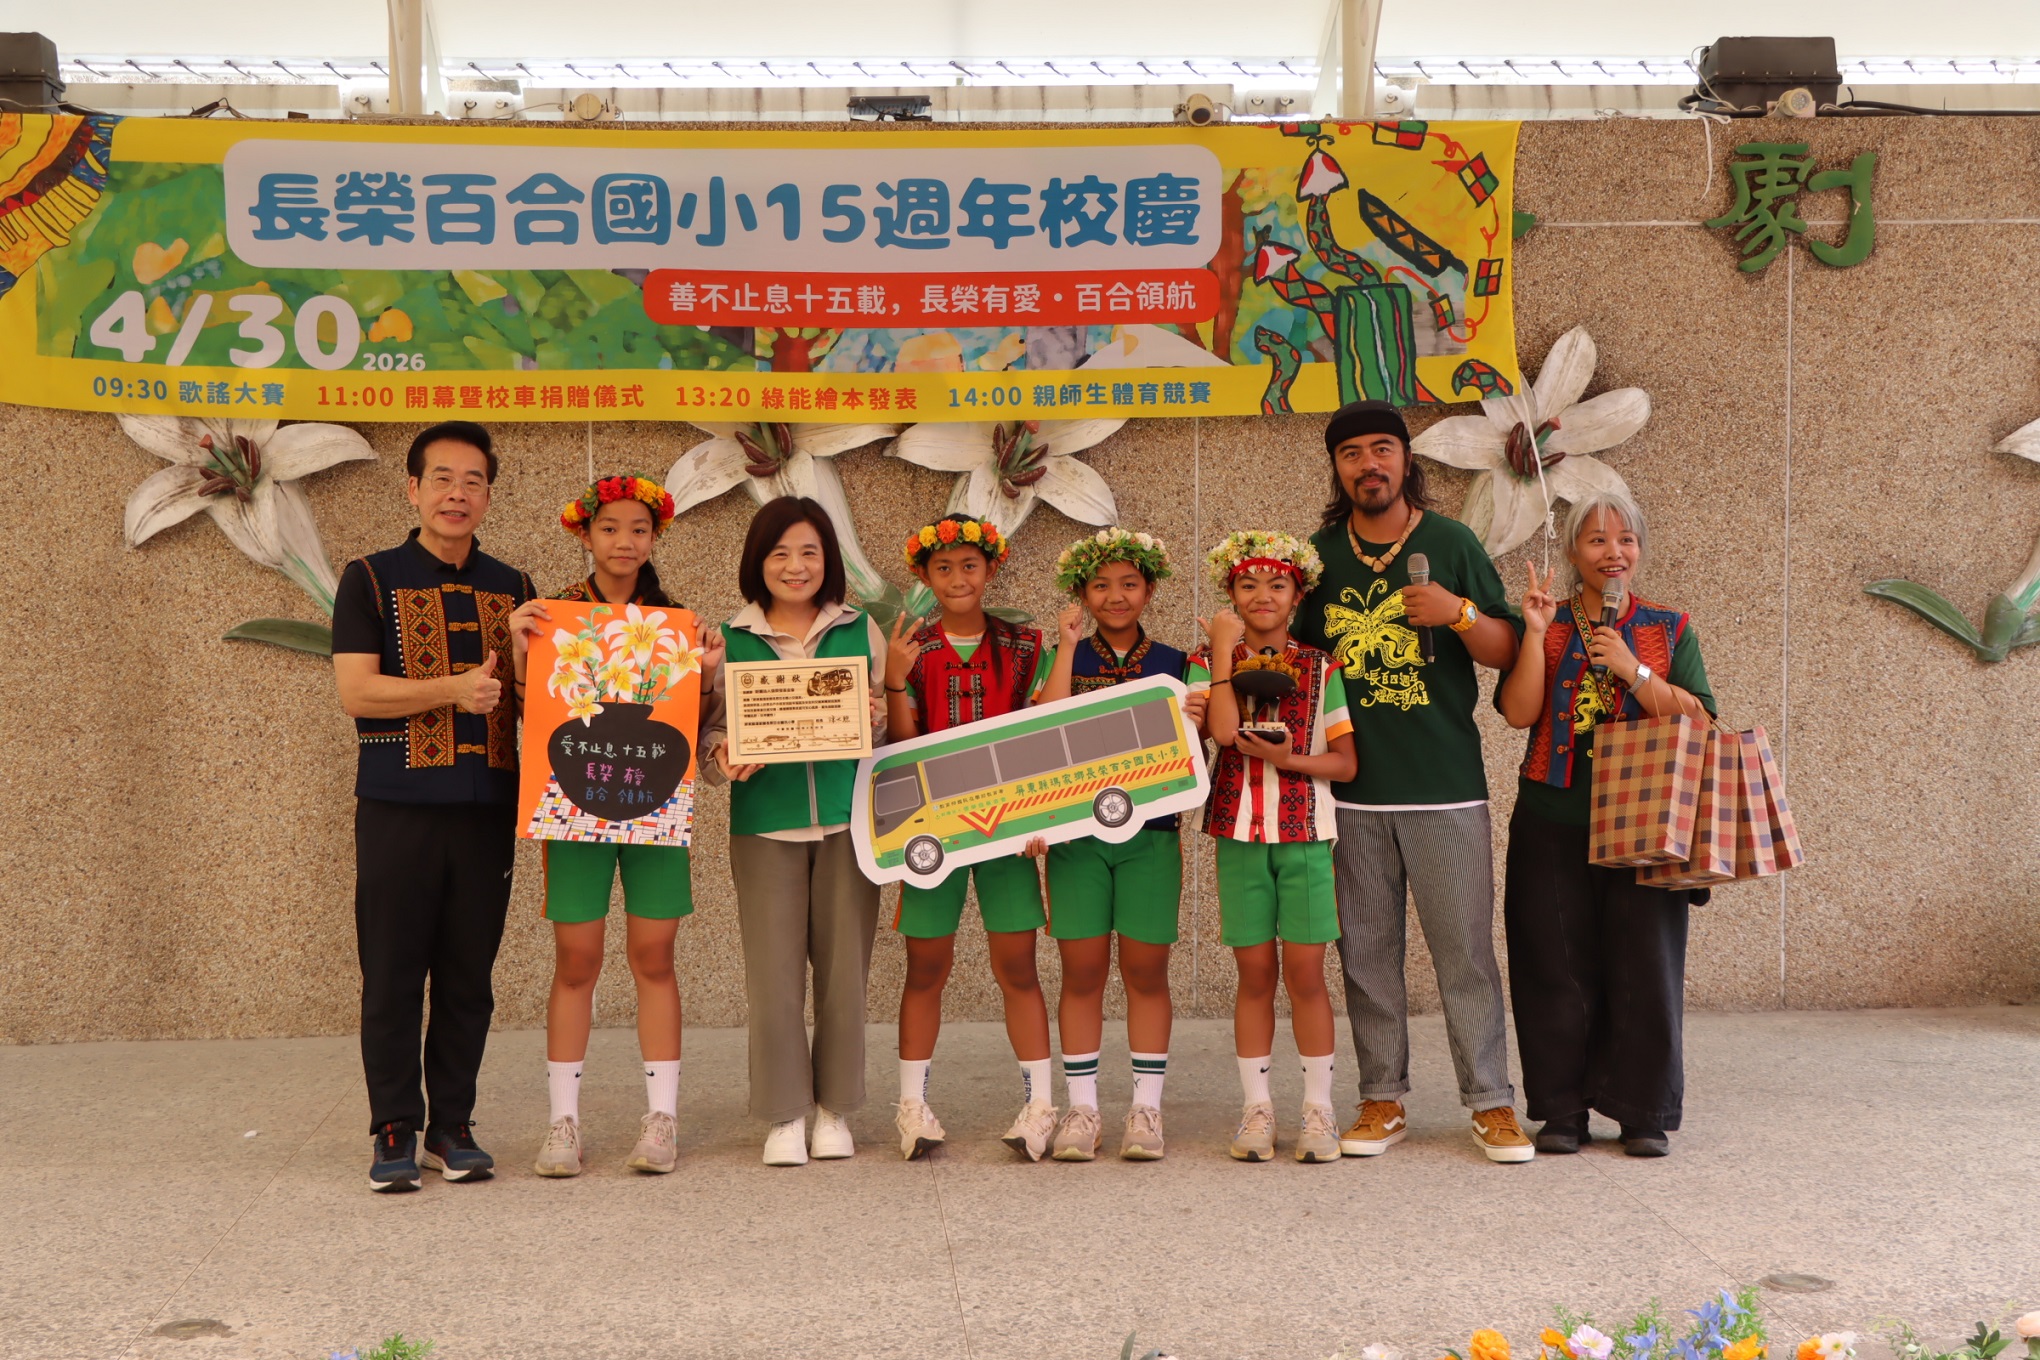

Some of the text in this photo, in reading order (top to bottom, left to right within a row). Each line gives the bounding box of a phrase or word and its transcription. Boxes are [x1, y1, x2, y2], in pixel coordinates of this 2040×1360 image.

[248, 171, 1201, 249] 長榮百合國小15週年校慶
[90, 291, 359, 370] 4/30
[363, 353, 426, 371] 2026
[93, 377, 285, 406] 09:30 歌謠大賽
[317, 383, 645, 409] 11:00 開幕暨校車捐贈儀式
[676, 386, 918, 411] 13:20 綠能繪本發表
[948, 381, 1211, 407] 14:00 親師生體育競賽
